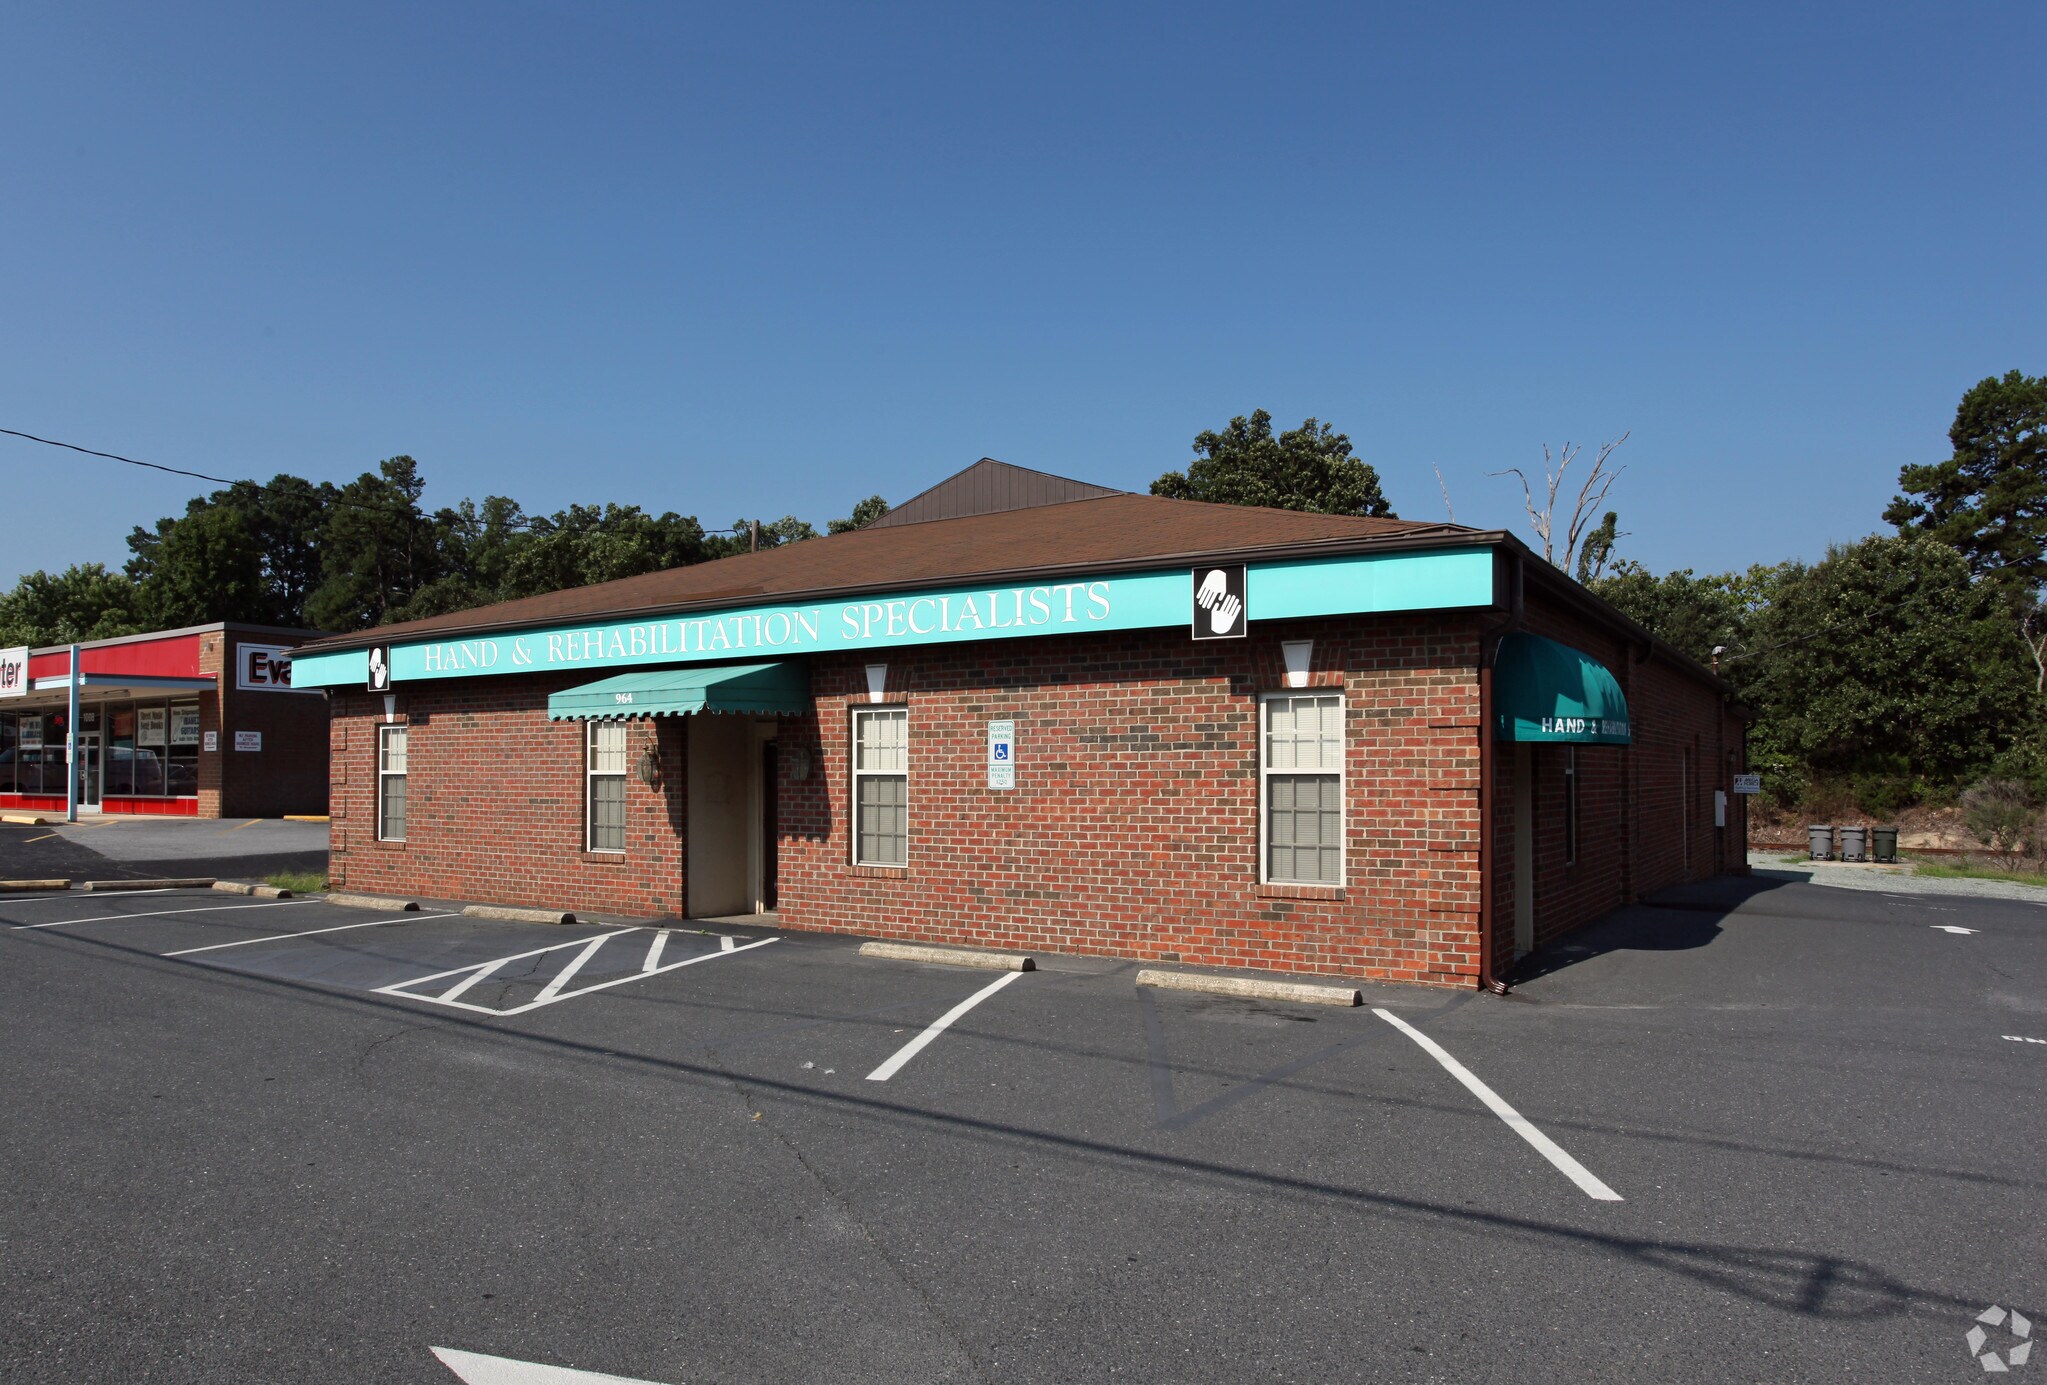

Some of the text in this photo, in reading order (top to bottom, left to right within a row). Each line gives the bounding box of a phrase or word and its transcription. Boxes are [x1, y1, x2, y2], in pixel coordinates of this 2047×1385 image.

[424, 580, 1111, 672] HAND & REHABILITATION SPECIALISTS
[0, 658, 21, 688] ter
[249, 651, 291, 686] Eva
[615, 692, 633, 705] 964
[1541, 717, 1585, 734] HAND
[1590, 719, 1598, 735] &
